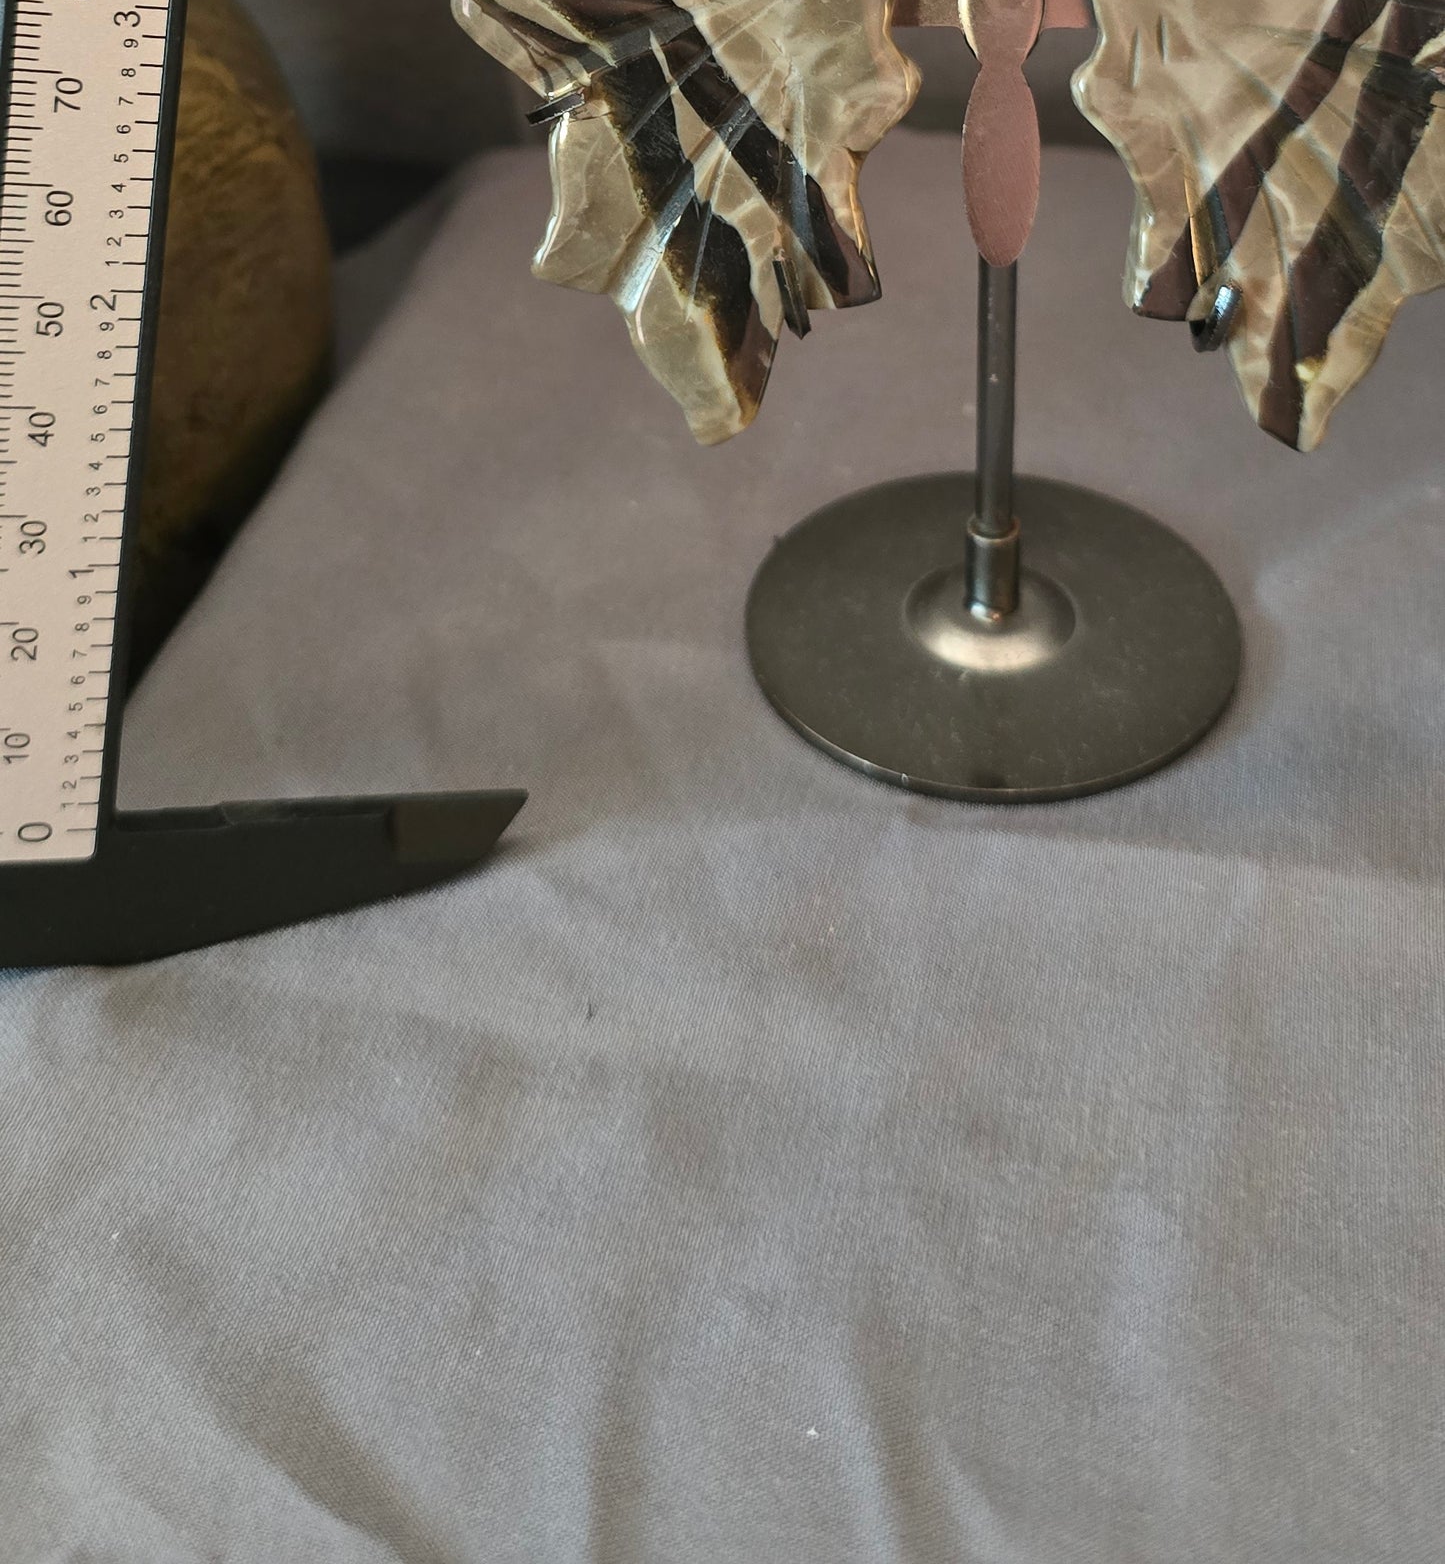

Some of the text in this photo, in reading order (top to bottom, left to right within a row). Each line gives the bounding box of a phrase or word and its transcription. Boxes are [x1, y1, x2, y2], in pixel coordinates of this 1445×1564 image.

[113, 10, 141, 28] 3
[123, 38, 139, 49] 9
[120, 67, 137, 78] 8
[53, 77, 83, 113] 70
[118, 96, 134, 106] 7
[115, 124, 132, 135] 6
[113, 153, 129, 164] 5
[110, 182, 127, 193] 4
[44, 190, 74, 227] 60
[108, 209, 125, 219] 3
[106, 236, 123, 248] 2
[89, 294, 117, 312] 2
[35, 301, 65, 338] 50
[98, 321, 115, 332] 9
[96, 349, 113, 360] 8
[94, 377, 111, 388] 7
[92, 404, 108, 415] 6
[27, 411, 56, 448] 40
[90, 432, 106, 443] 5
[88, 461, 103, 471] 4
[84, 486, 102, 497] 3
[83, 512, 100, 524] 2
[18, 520, 48, 555] 30
[81, 535, 97, 543] 1
[68, 568, 95, 579] 1
[76, 595, 93, 606] 9
[74, 622, 90, 633] 8
[10, 627, 39, 662] 20
[71, 648, 88, 660] 7
[70, 675, 86, 686] 6
[68, 700, 83, 713] 5
[66, 729, 81, 740] 4
[2, 732, 31, 765] 10
[62, 754, 80, 765] 3
[61, 779, 78, 791] 2
[59, 801, 76, 811] 1
[17, 821, 53, 843] 0
